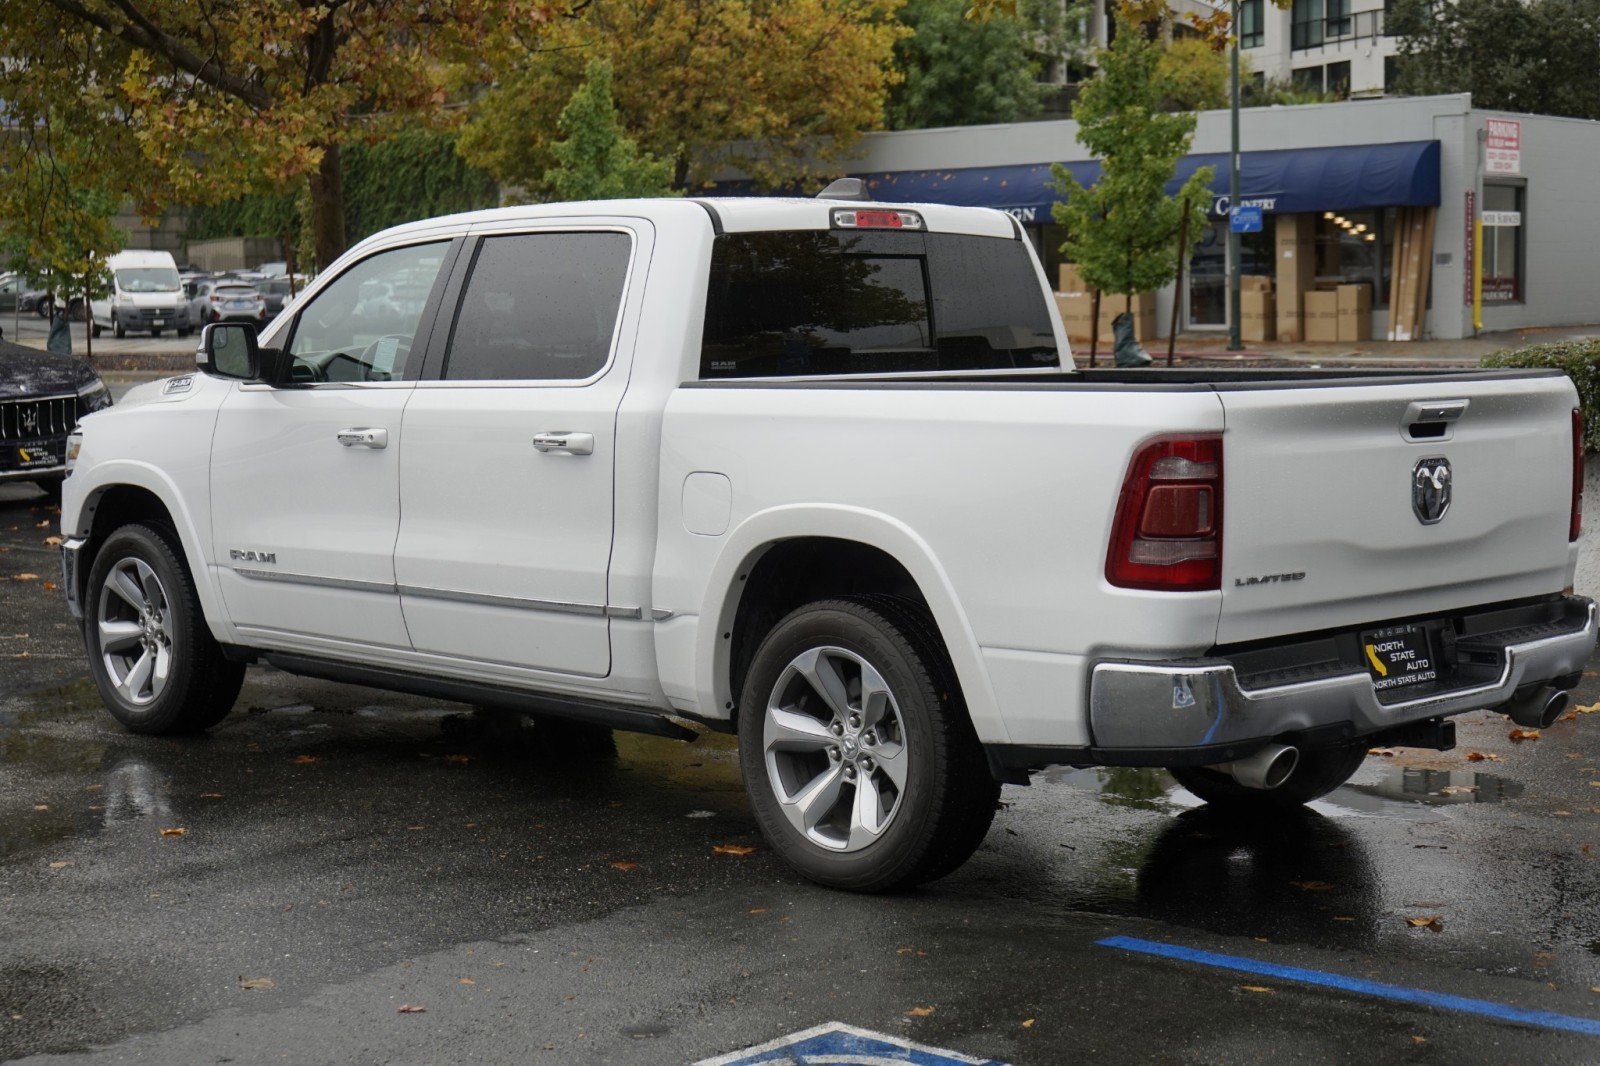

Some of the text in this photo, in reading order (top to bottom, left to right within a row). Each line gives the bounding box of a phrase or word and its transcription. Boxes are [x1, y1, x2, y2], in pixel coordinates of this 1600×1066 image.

[229, 549, 276, 564] RAM
[1235, 572, 1306, 587] LIMITED
[1373, 640, 1405, 653] NORTH
[1390, 650, 1415, 662] STATE
[1406, 659, 1429, 671] AUTO
[1372, 671, 1436, 690] NORTH STATE AUTO
